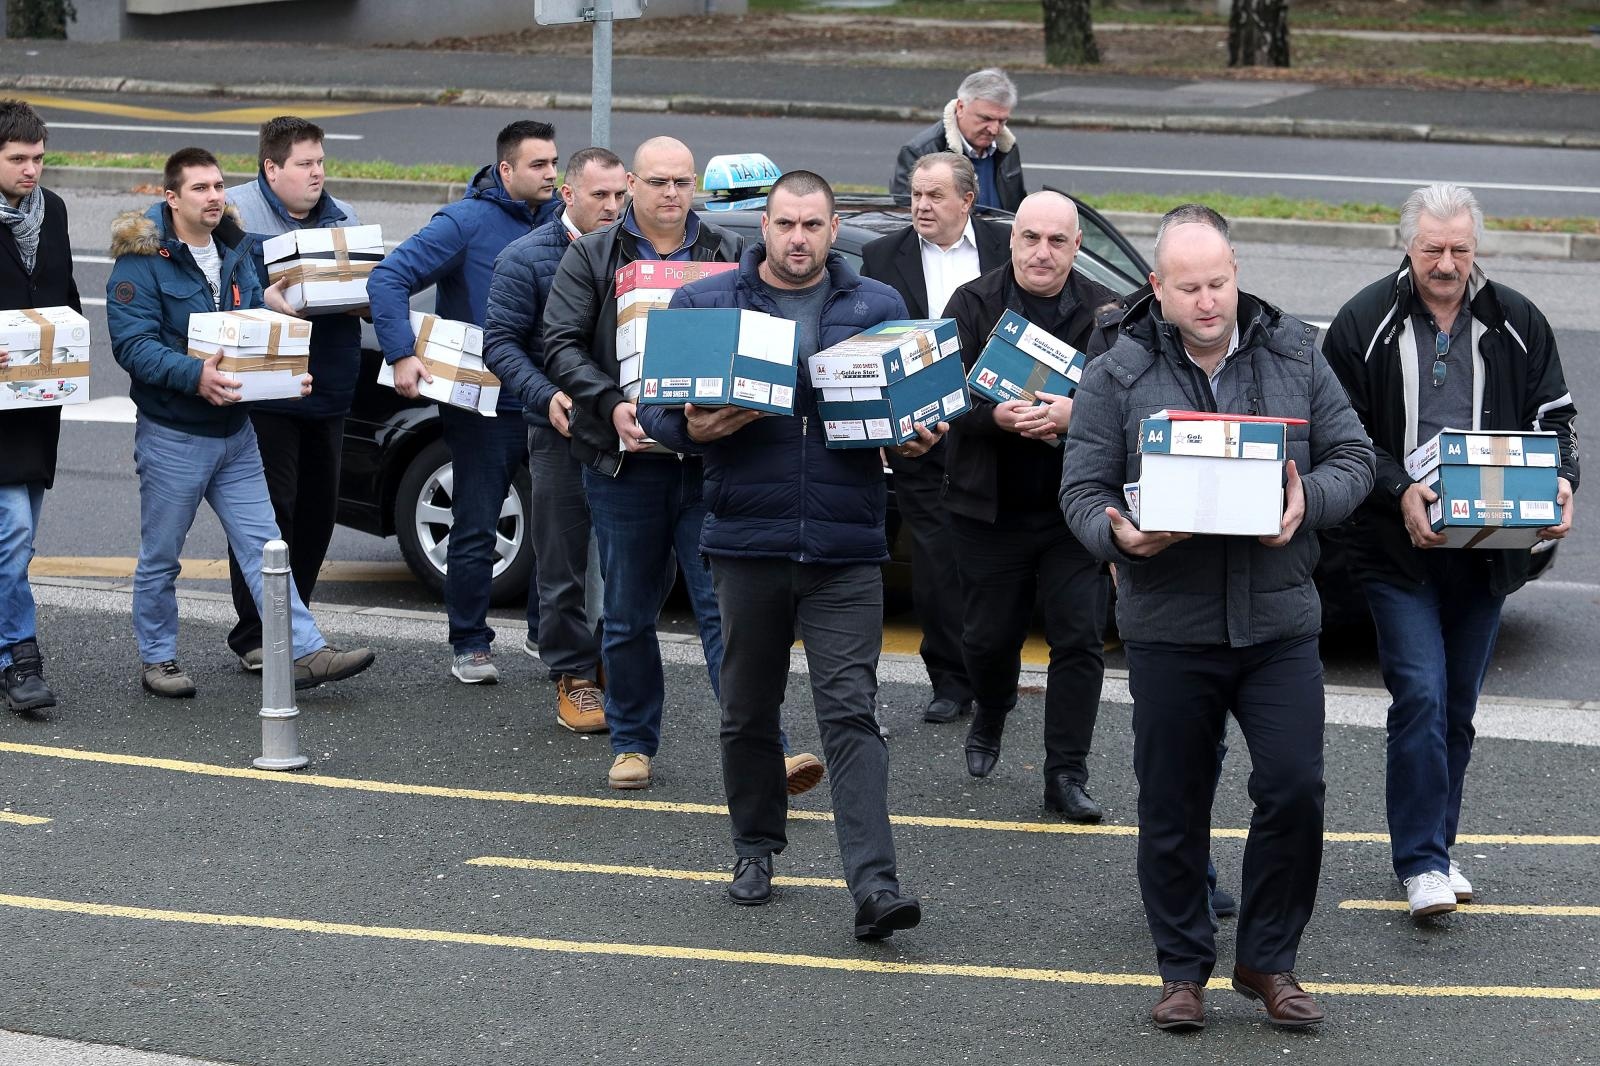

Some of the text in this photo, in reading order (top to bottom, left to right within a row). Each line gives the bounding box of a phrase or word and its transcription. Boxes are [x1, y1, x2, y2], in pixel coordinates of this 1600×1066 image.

[730, 162, 777, 180] TAXI
[1004, 322, 1019, 334] A4
[1034, 337, 1068, 359] Golden Star
[890, 358, 900, 374] A4
[737, 379, 746, 388] A4
[979, 372, 995, 387] A4
[645, 381, 657, 395] A4
[901, 418, 912, 434] A4
[1147, 430, 1164, 443] A4
[1448, 443, 1462, 455] A4
[1453, 502, 1468, 515] A4
[1477, 511, 1513, 519] 2500 SHEETS
